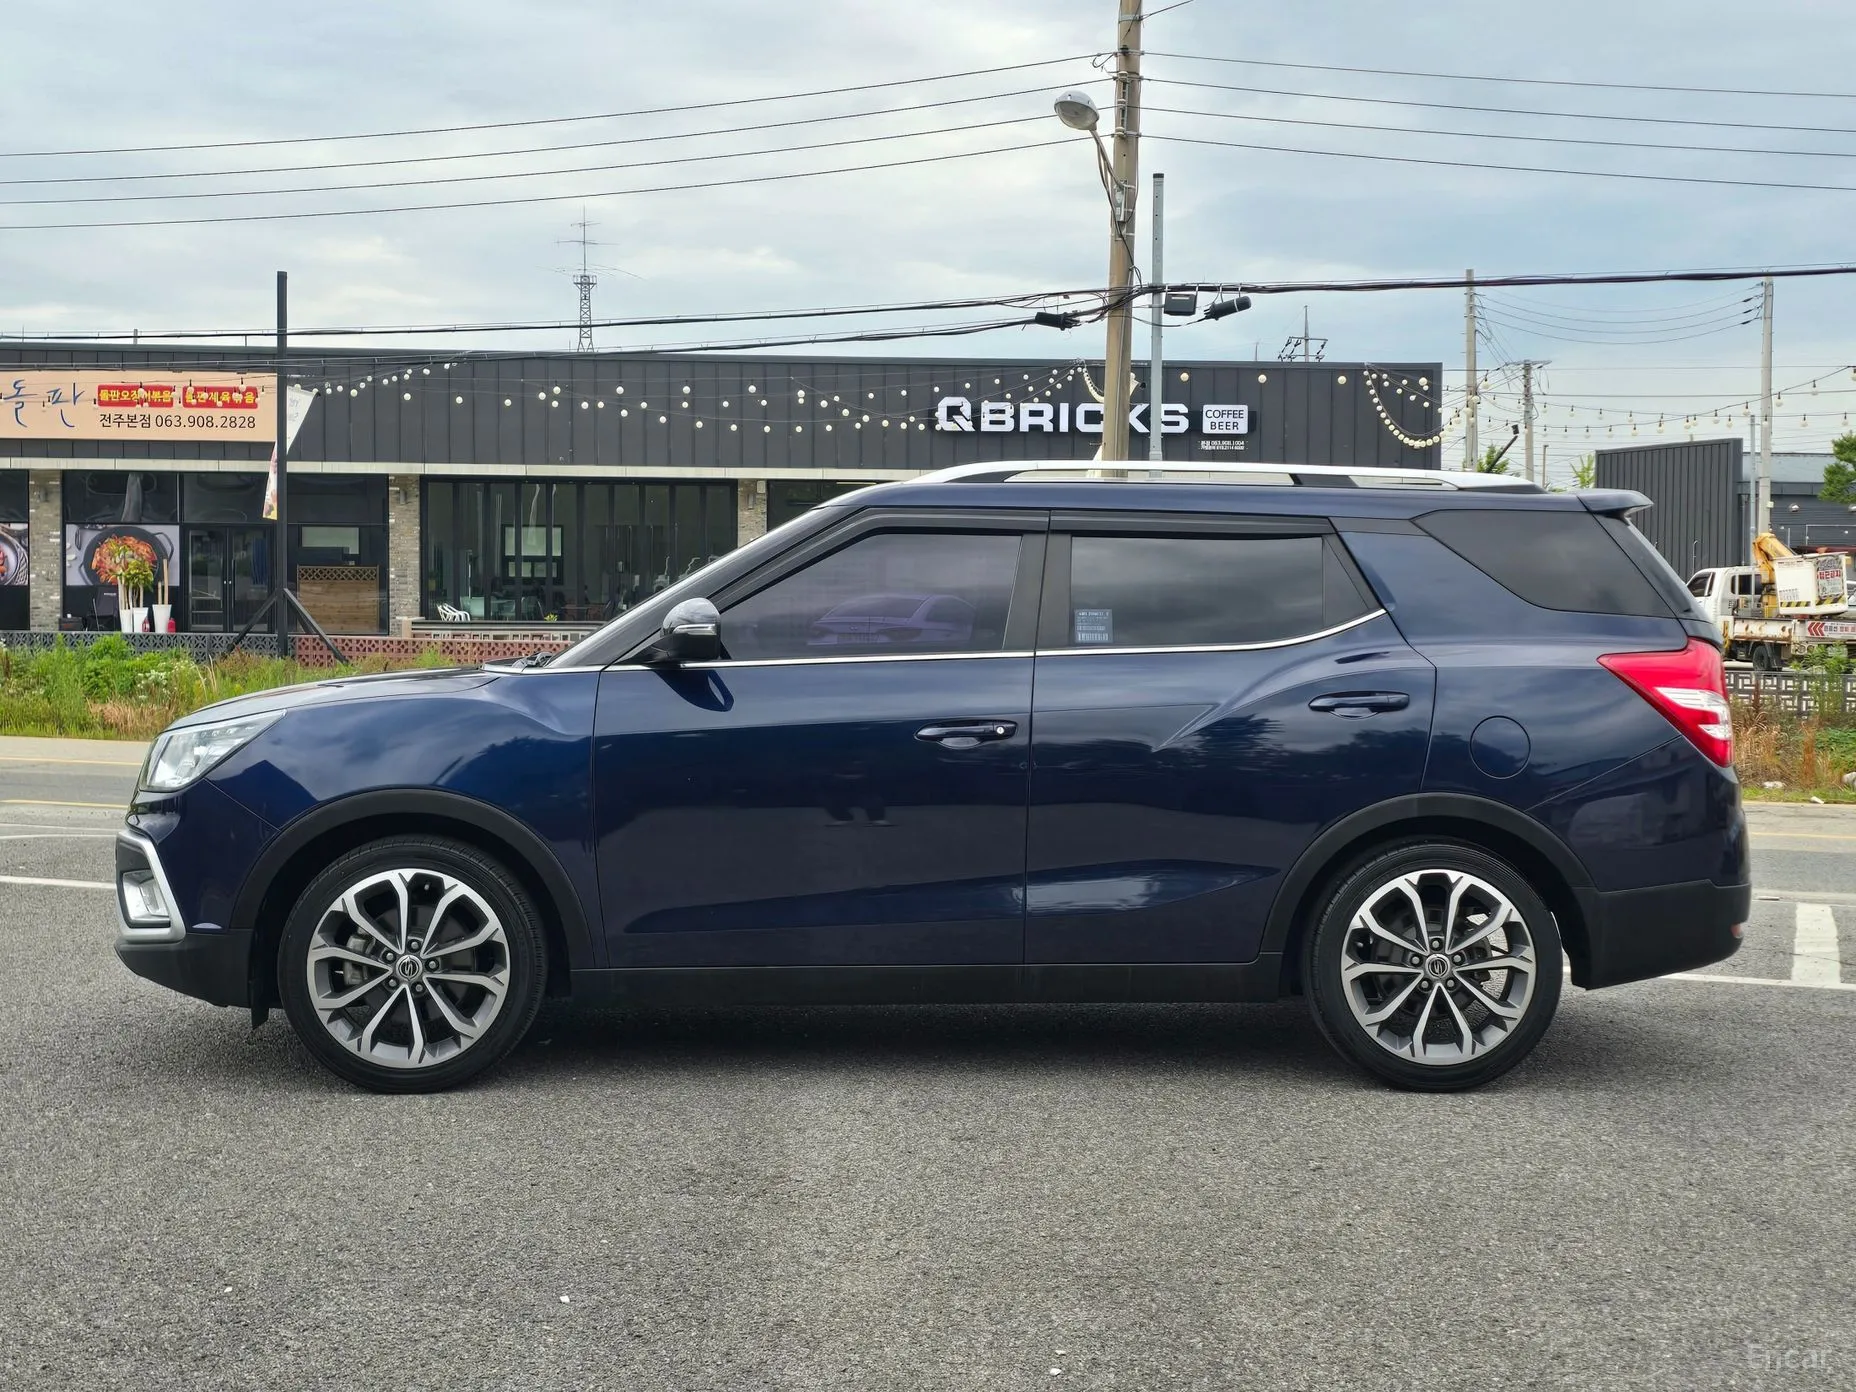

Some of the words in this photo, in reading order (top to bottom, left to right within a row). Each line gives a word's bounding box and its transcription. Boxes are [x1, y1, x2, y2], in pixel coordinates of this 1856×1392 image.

[1205, 409, 1244, 419] COFFEE
[99, 413, 151, 428] 전주본점
[155, 415, 256, 429] 063.908.2828
[1210, 421, 1239, 430] BEER
